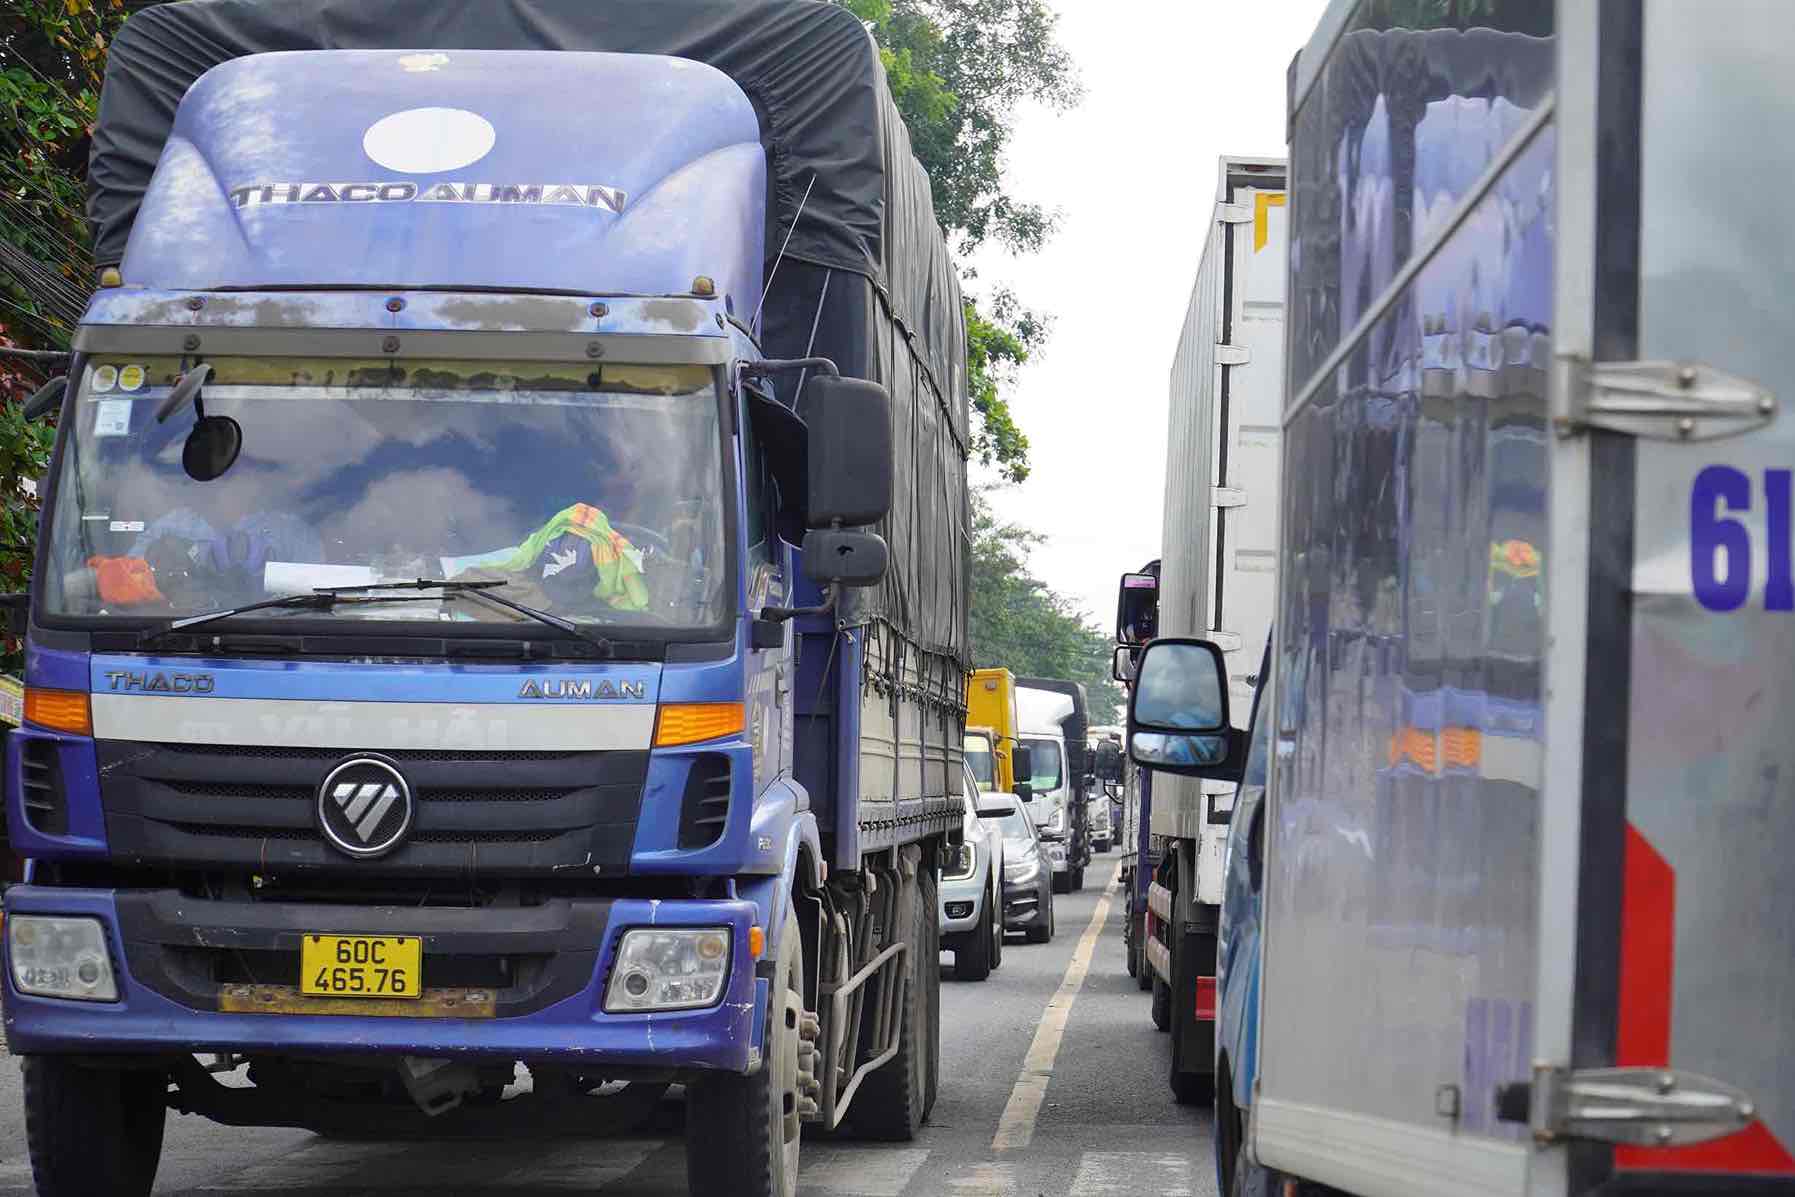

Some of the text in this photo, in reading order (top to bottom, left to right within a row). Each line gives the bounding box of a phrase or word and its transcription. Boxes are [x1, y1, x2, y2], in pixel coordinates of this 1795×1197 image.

[231, 182, 627, 213] THACO AUMAN
[104, 671, 215, 694] THACO
[518, 678, 645, 700] AUMAN
[336, 940, 386, 964] 60C
[314, 967, 406, 993] 465.76
